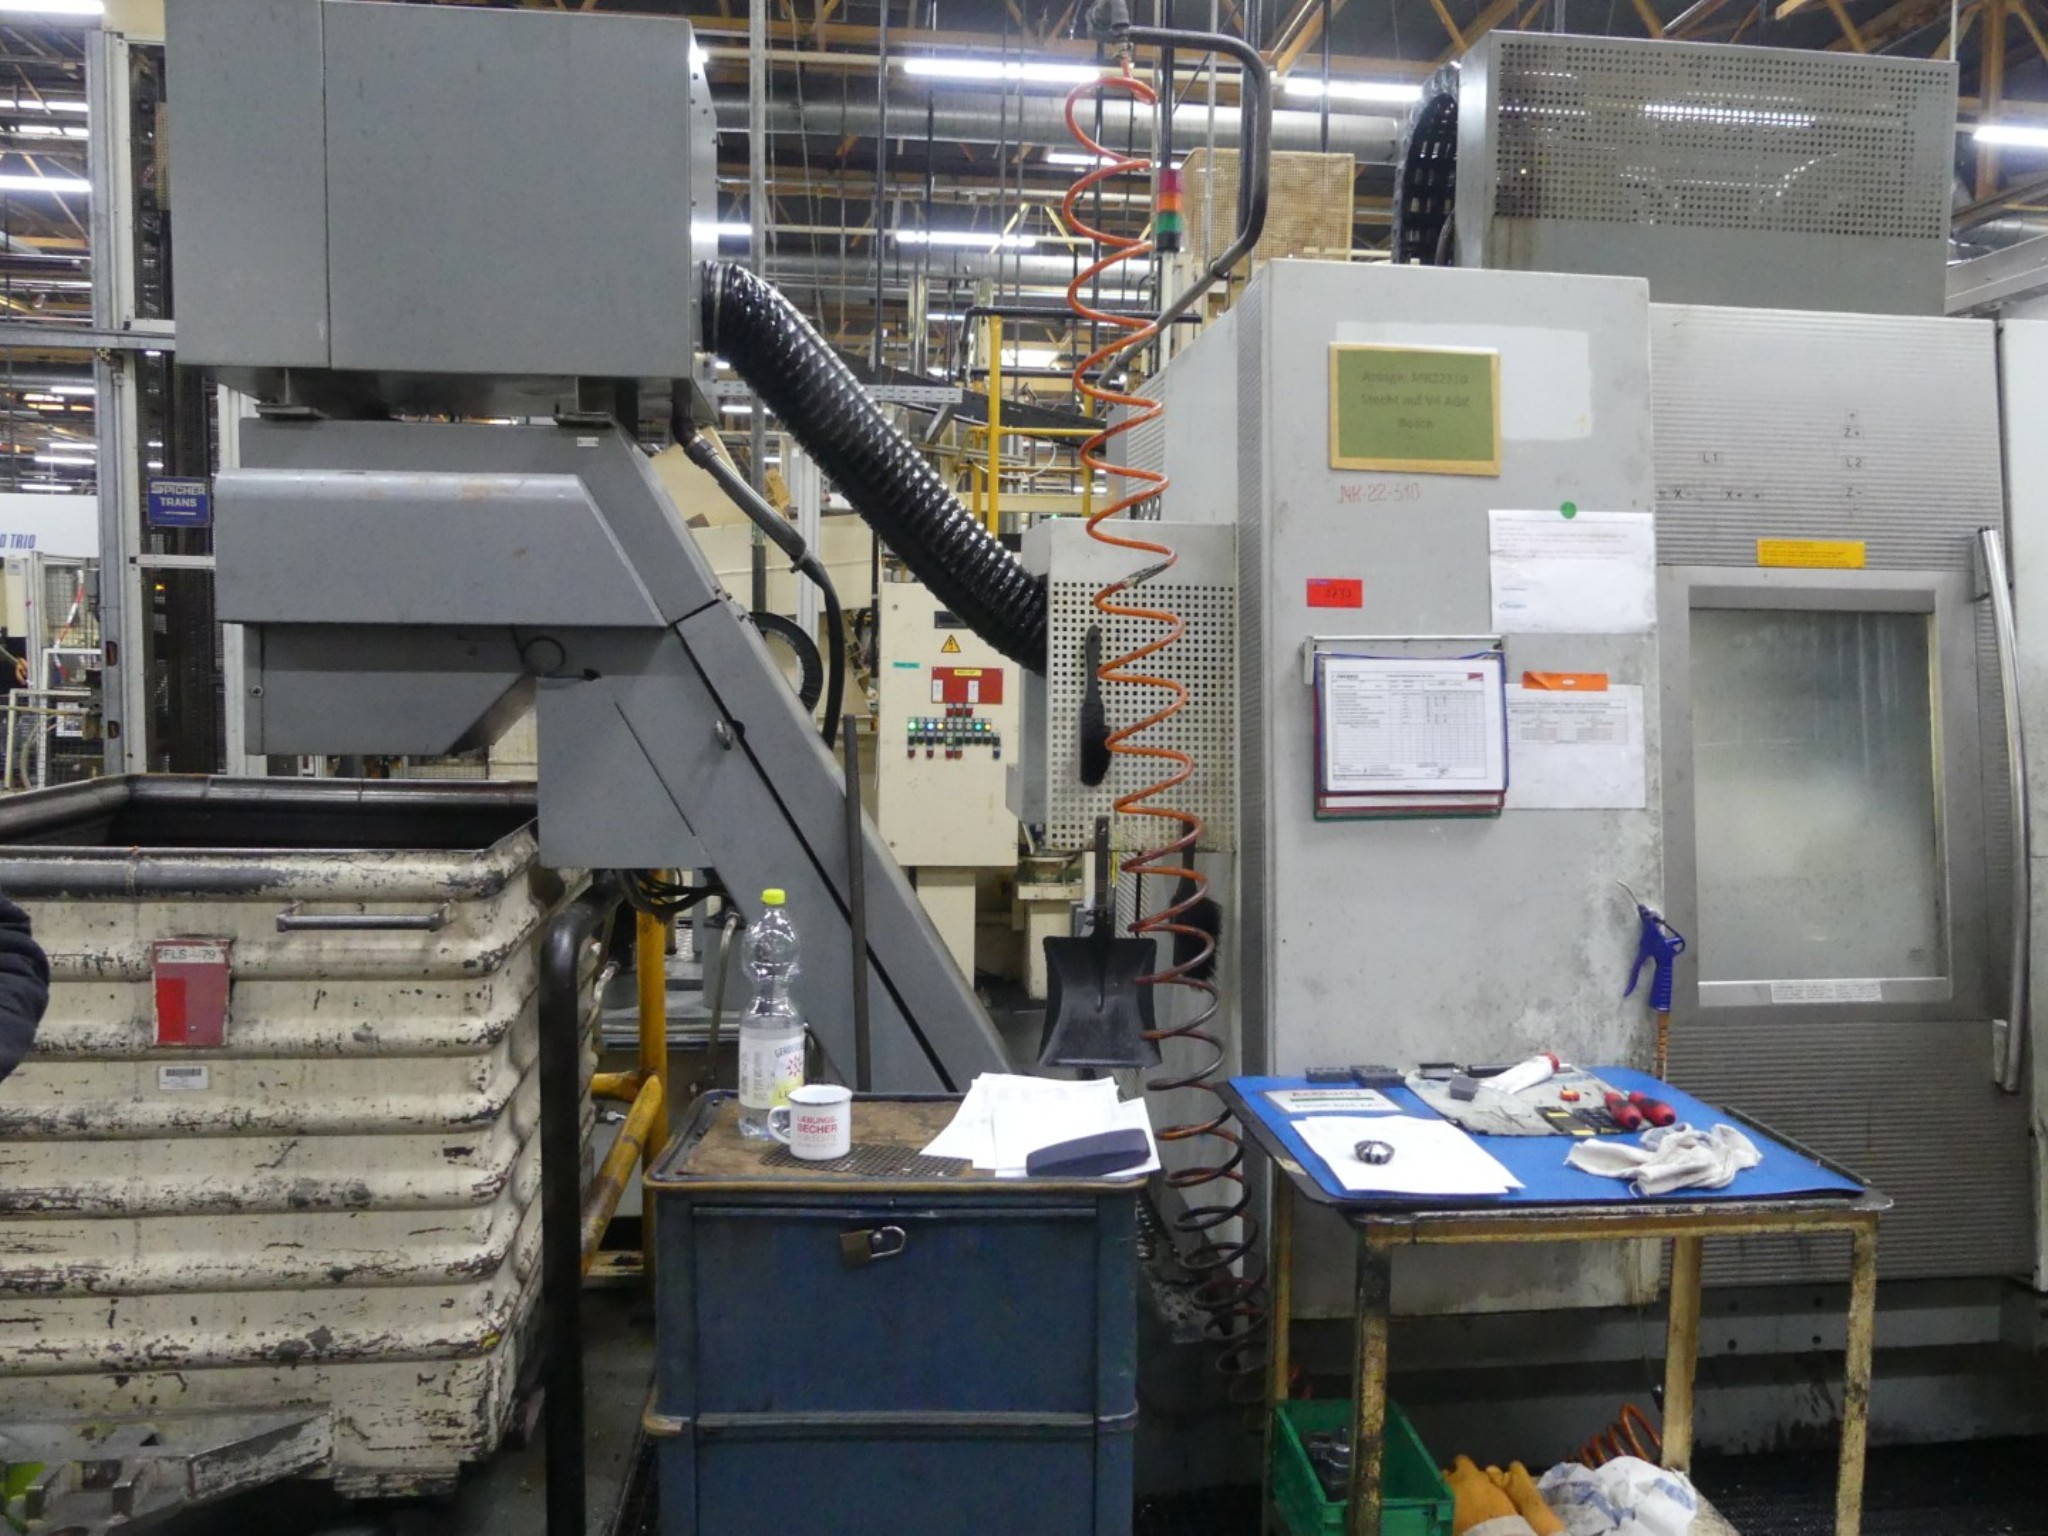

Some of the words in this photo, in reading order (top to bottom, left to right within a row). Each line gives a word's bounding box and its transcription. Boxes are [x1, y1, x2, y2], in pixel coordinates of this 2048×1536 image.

[151, 481, 206, 496] SPICHER
[160, 497, 197, 507] TRANS
[797, 1123, 838, 1135] BECHER
